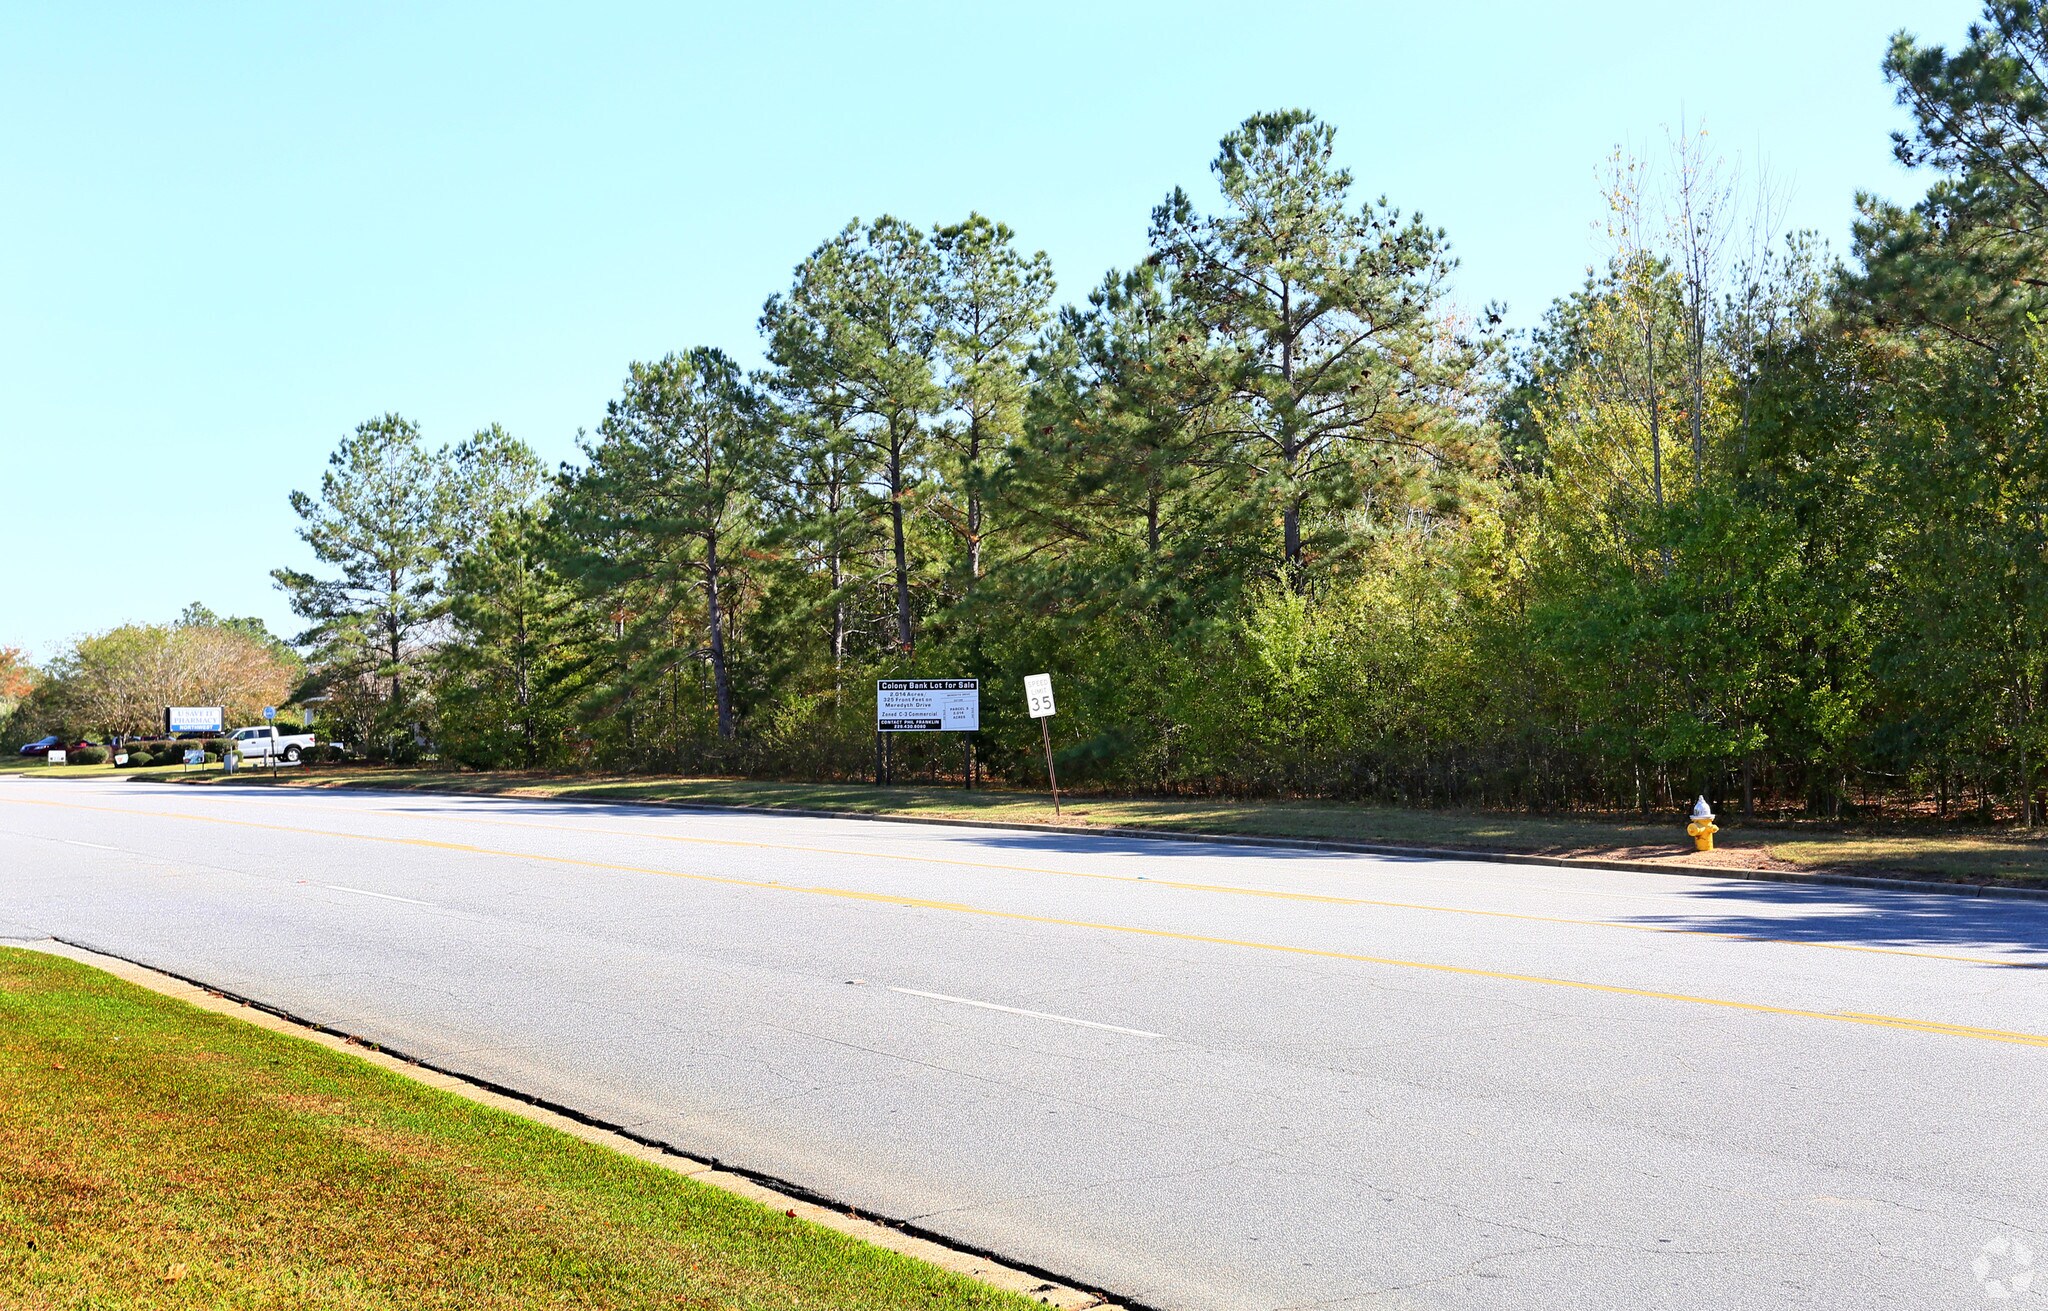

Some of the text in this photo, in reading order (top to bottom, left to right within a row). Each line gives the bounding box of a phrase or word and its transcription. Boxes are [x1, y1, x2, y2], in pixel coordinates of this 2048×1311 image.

[881, 682, 907, 690] Colony
[958, 681, 975, 689] Sale
[1028, 679, 1048, 688] SPEED
[1032, 696, 1052, 712] 35
